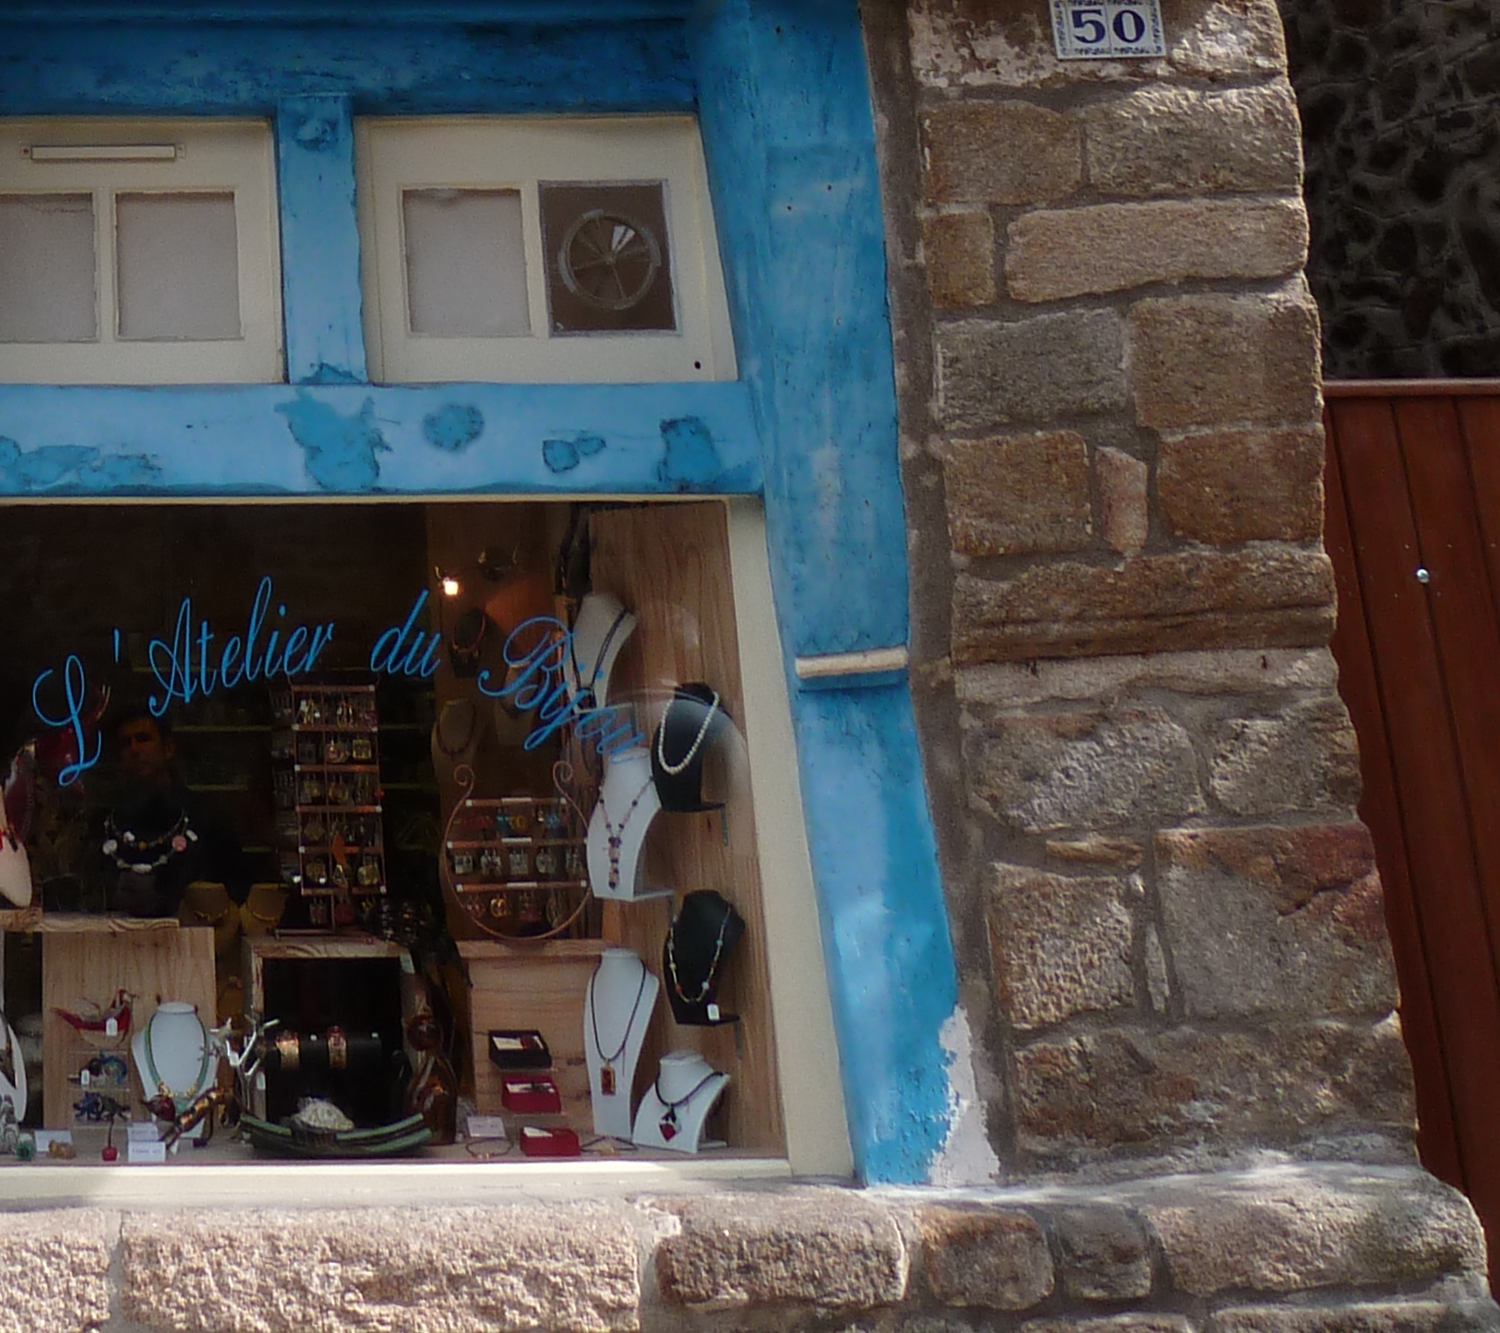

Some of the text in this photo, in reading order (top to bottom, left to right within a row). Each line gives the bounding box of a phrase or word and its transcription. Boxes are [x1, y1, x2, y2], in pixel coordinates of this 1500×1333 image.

[1071, 9, 1146, 44] 50
[32, 575, 649, 787] L'Atelier du Bijou
